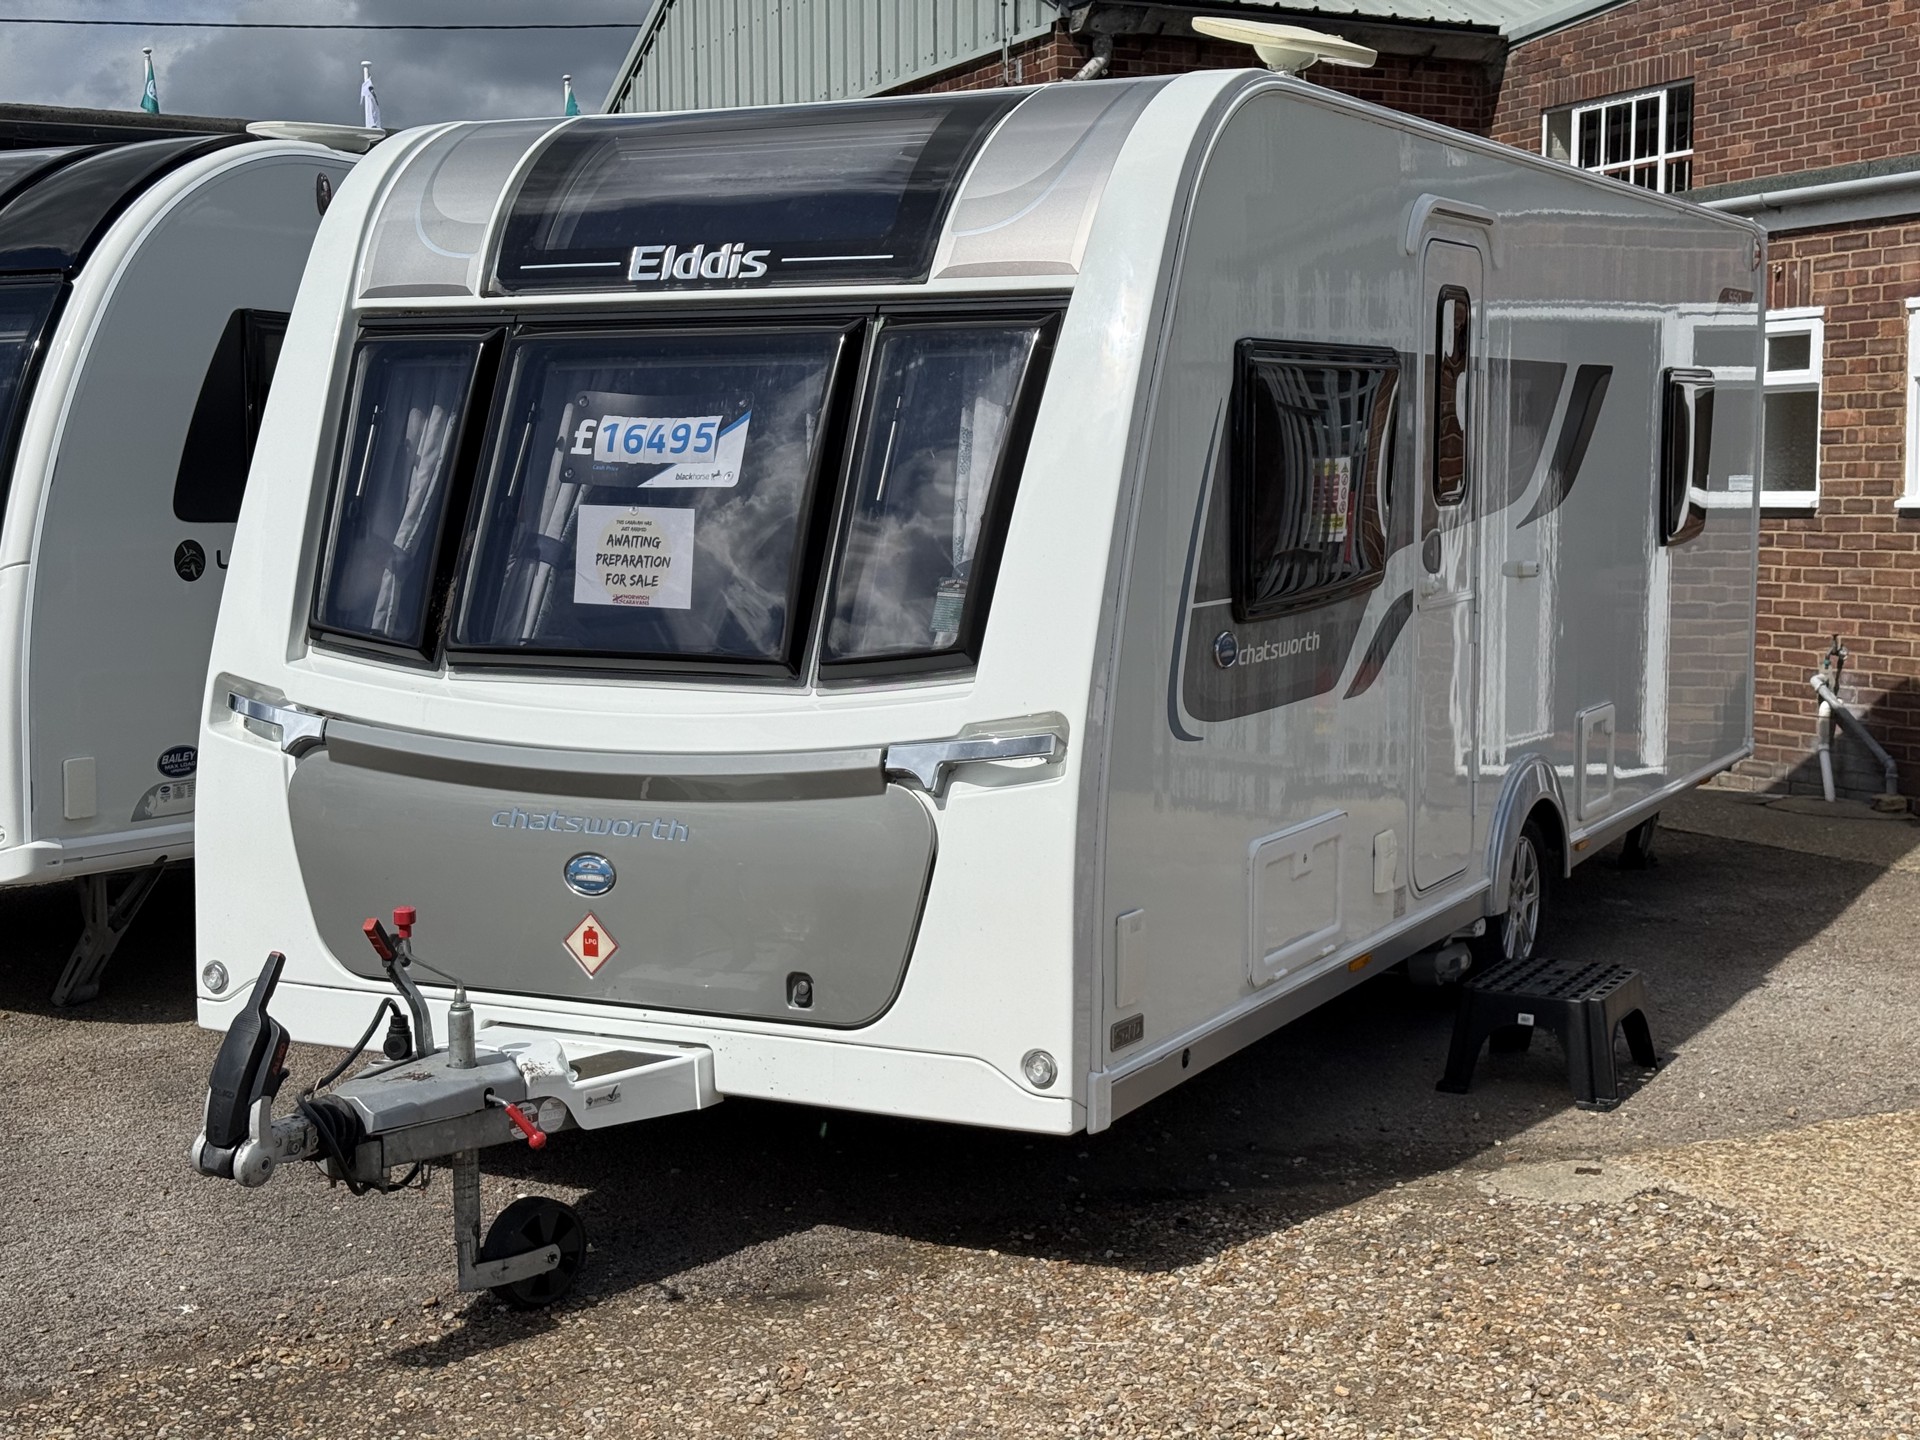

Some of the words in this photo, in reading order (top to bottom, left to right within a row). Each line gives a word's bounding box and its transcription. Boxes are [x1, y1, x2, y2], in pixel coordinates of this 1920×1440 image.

[628, 243, 771, 280] Elddis
[675, 472, 710, 481] blackhorse
[606, 534, 662, 549] AWAITING
[595, 553, 671, 569] PREPARATION
[605, 573, 627, 587] FOR
[629, 574, 659, 588] SALE
[1238, 631, 1320, 666] chatsworth
[161, 751, 197, 765] BAILEY
[491, 806, 690, 842] chatsworth
[584, 937, 597, 946] LPG
